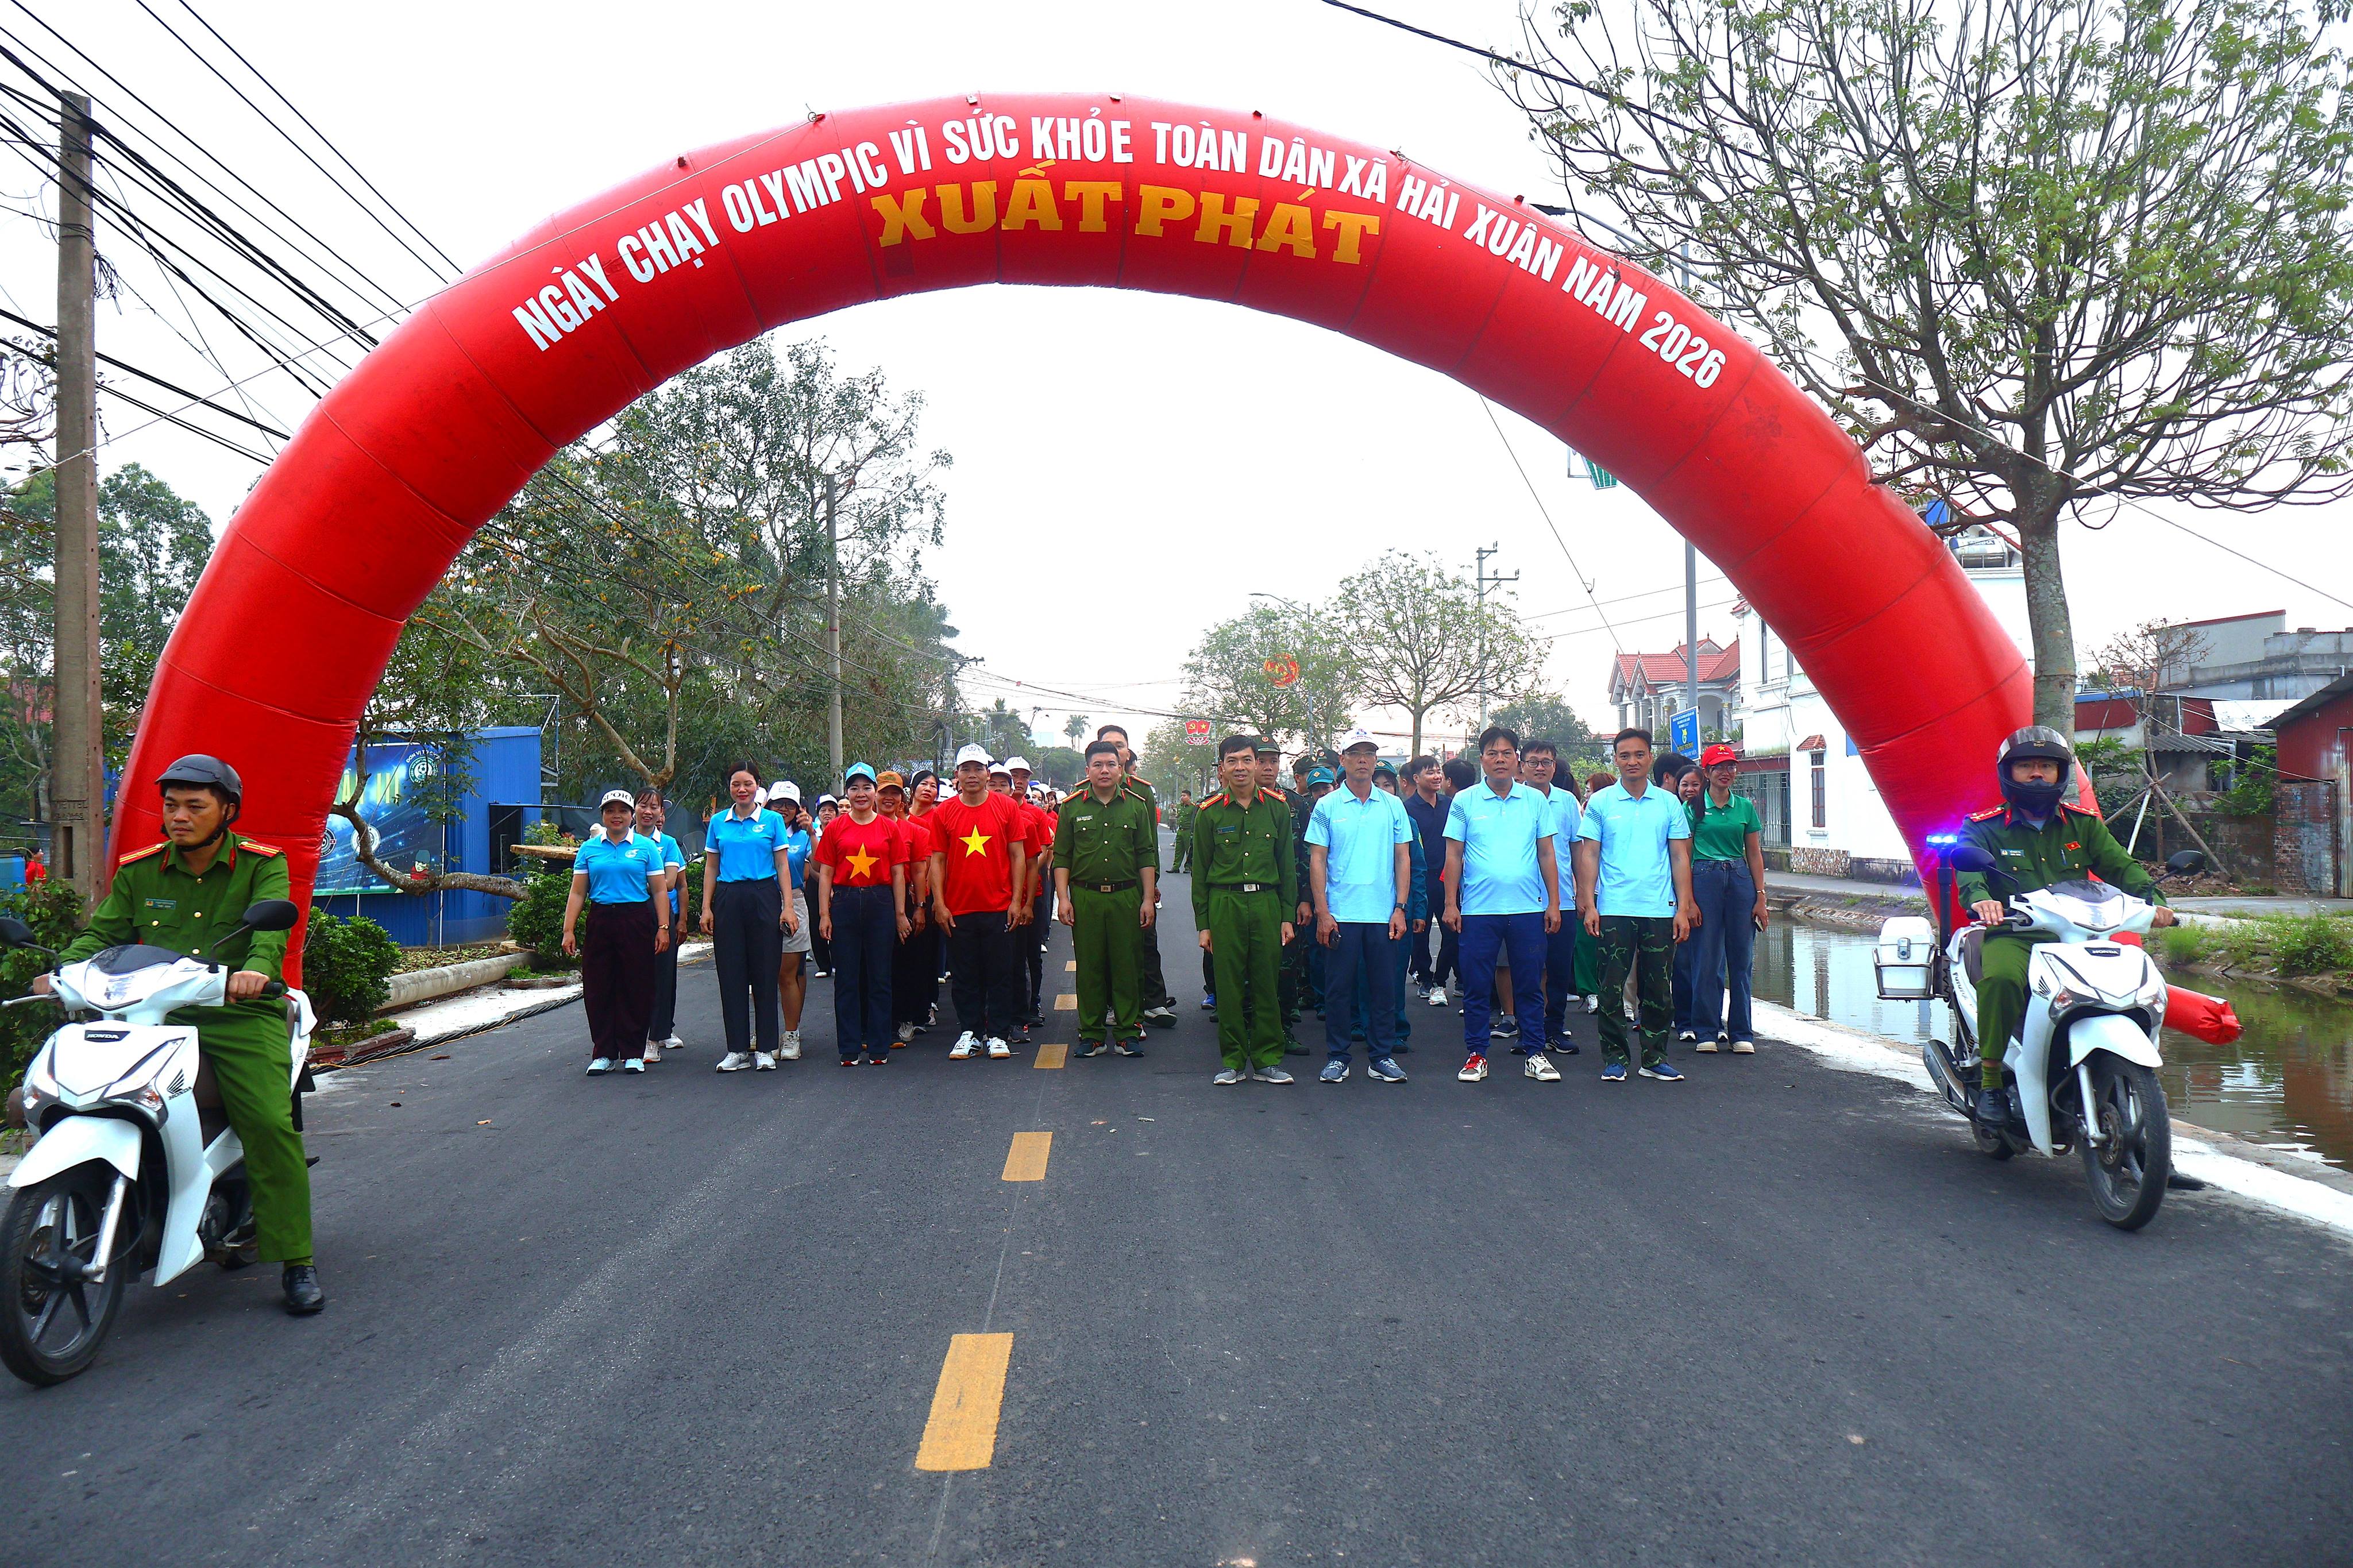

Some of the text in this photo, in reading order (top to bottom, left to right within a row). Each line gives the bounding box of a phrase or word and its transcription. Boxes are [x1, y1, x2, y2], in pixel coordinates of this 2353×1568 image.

[511, 253, 620, 352] NGÀY
[617, 197, 720, 283] CHẠY
[722, 141, 888, 233] OLYMPIC
[888, 119, 932, 175] VÌ
[942, 107, 1019, 164] SỨC
[1031, 106, 1133, 163] KHỎE
[1151, 120, 1247, 173] TOÀN
[1258, 136, 1336, 188] DÂN
[1337, 154, 1387, 204] XÃ
[1396, 173, 1460, 230] HẢI
[1463, 202, 1564, 283] XUÂN
[1638, 311, 1726, 388] 2026
[870, 160, 1380, 264] XUẤT PHÁT
[169, 1086, 193, 1100] HONDA
